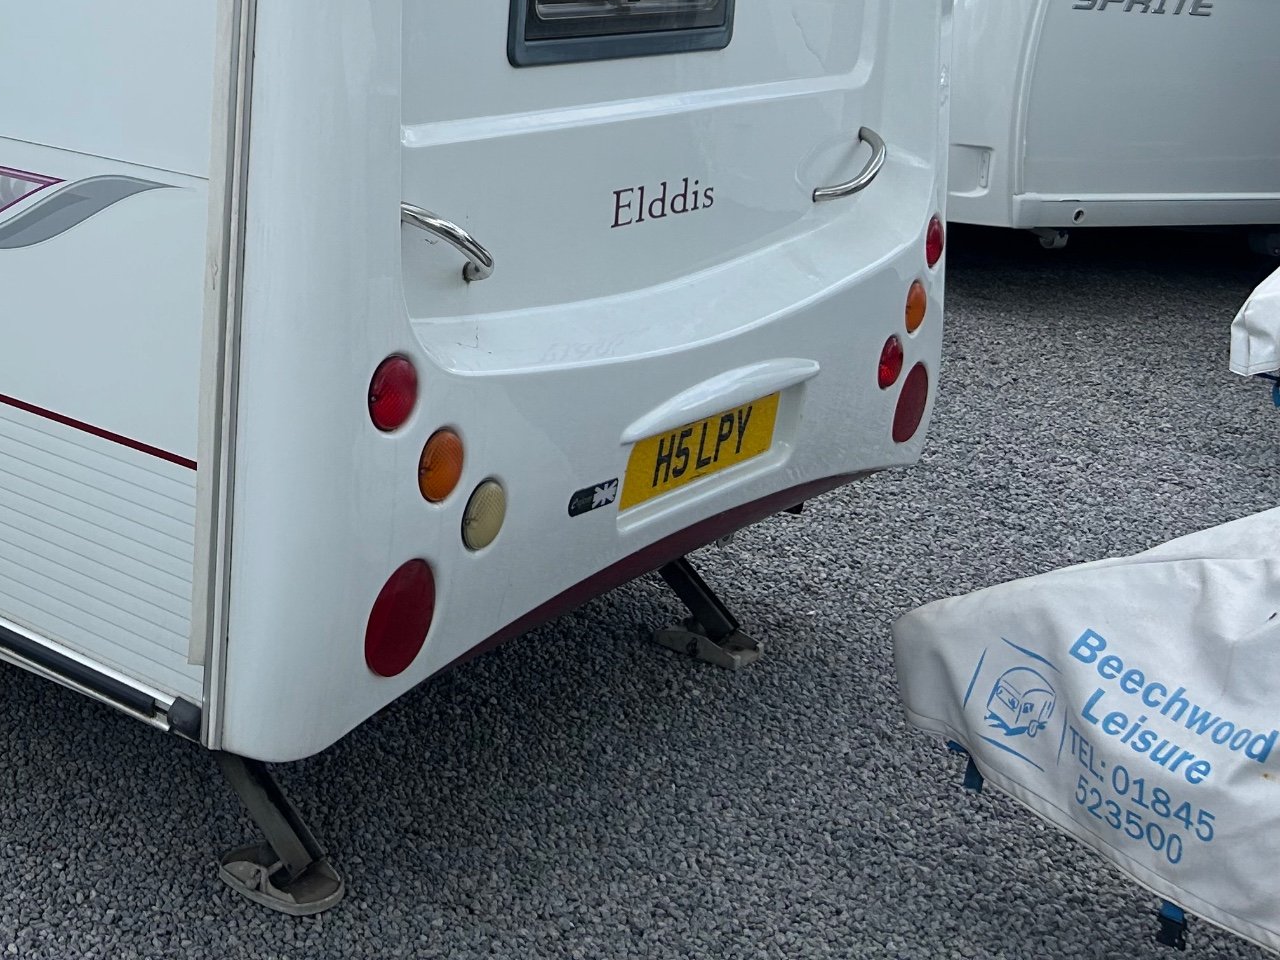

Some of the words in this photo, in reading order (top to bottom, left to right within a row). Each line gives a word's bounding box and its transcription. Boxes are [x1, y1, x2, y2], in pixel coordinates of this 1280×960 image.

[611, 177, 714, 228] Elddis
[1069, 628, 1279, 764] Beechwood
[1081, 687, 1211, 785] Leisure
[1070, 726, 1107, 783] TEL:
[1112, 765, 1216, 842] 01845
[1075, 775, 1183, 864] 523500
